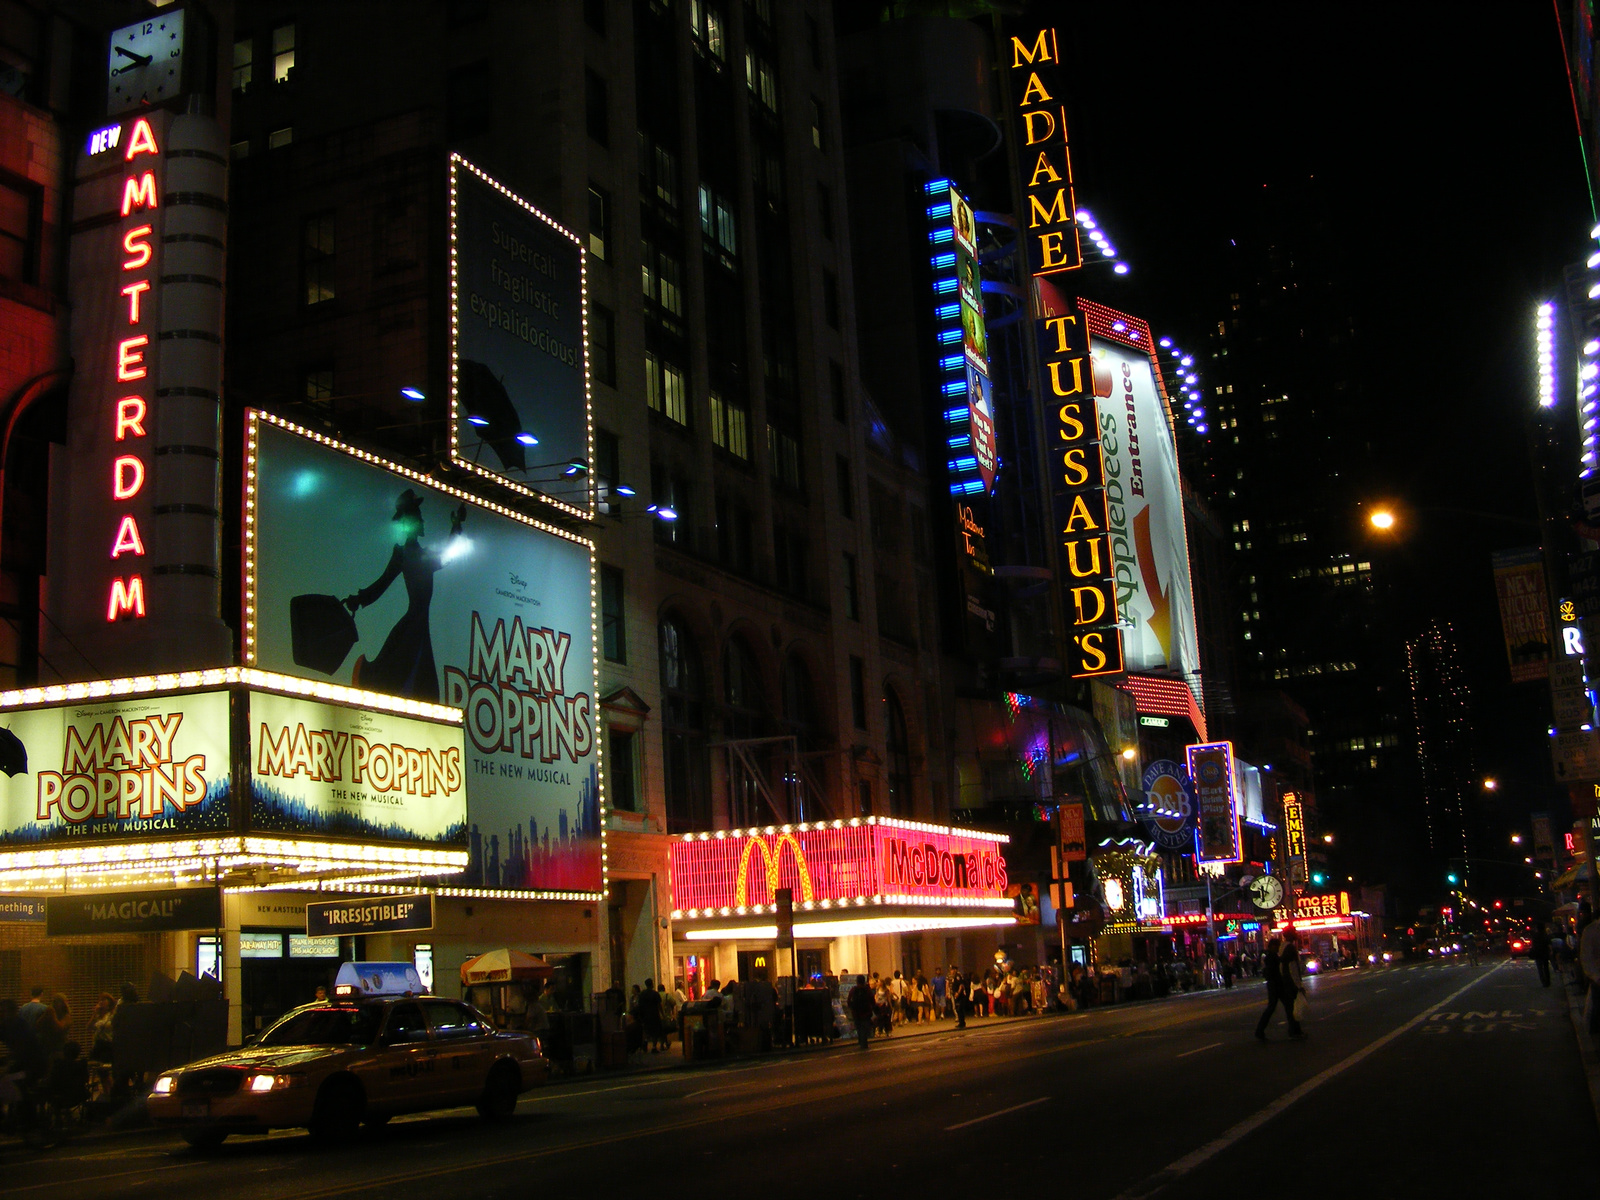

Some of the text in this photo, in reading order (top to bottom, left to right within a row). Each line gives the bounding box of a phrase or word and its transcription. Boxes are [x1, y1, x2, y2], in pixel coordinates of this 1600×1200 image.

[142, 23, 153, 36] 12
[89, 124, 122, 156] NEW
[1011, 28, 1071, 269] MADAME
[491, 221, 557, 280] Supercali
[490, 258, 560, 320] fragilistic
[470, 292, 579, 369] expialidocious!
[107, 117, 159, 624] AMSTERDAM
[1121, 361, 1144, 499] Entrance
[1046, 315, 1107, 671] TUSSAUD'S
[468, 610, 571, 695] MARY
[63, 712, 183, 775] MARY
[444, 665, 592, 763] POPPINS
[37, 754, 207, 823] POPPINS
[258, 722, 462, 797] MARY POPPINS
[473, 759, 571, 786] THE NEW MUSICAL
[1145, 763, 1188, 786] DAVE AND
[66, 819, 176, 836] THE NEW MUSICAL
[331, 788, 347, 800] THE
[350, 791, 368, 803] NEW
[371, 794, 404, 807] MUSICAL
[1145, 791, 1192, 818] D&B
[886, 838, 1008, 892] McDonald's
[37, 902, 45, 913] is
[323, 902, 414, 925] "IRRESISTIBLE!"
